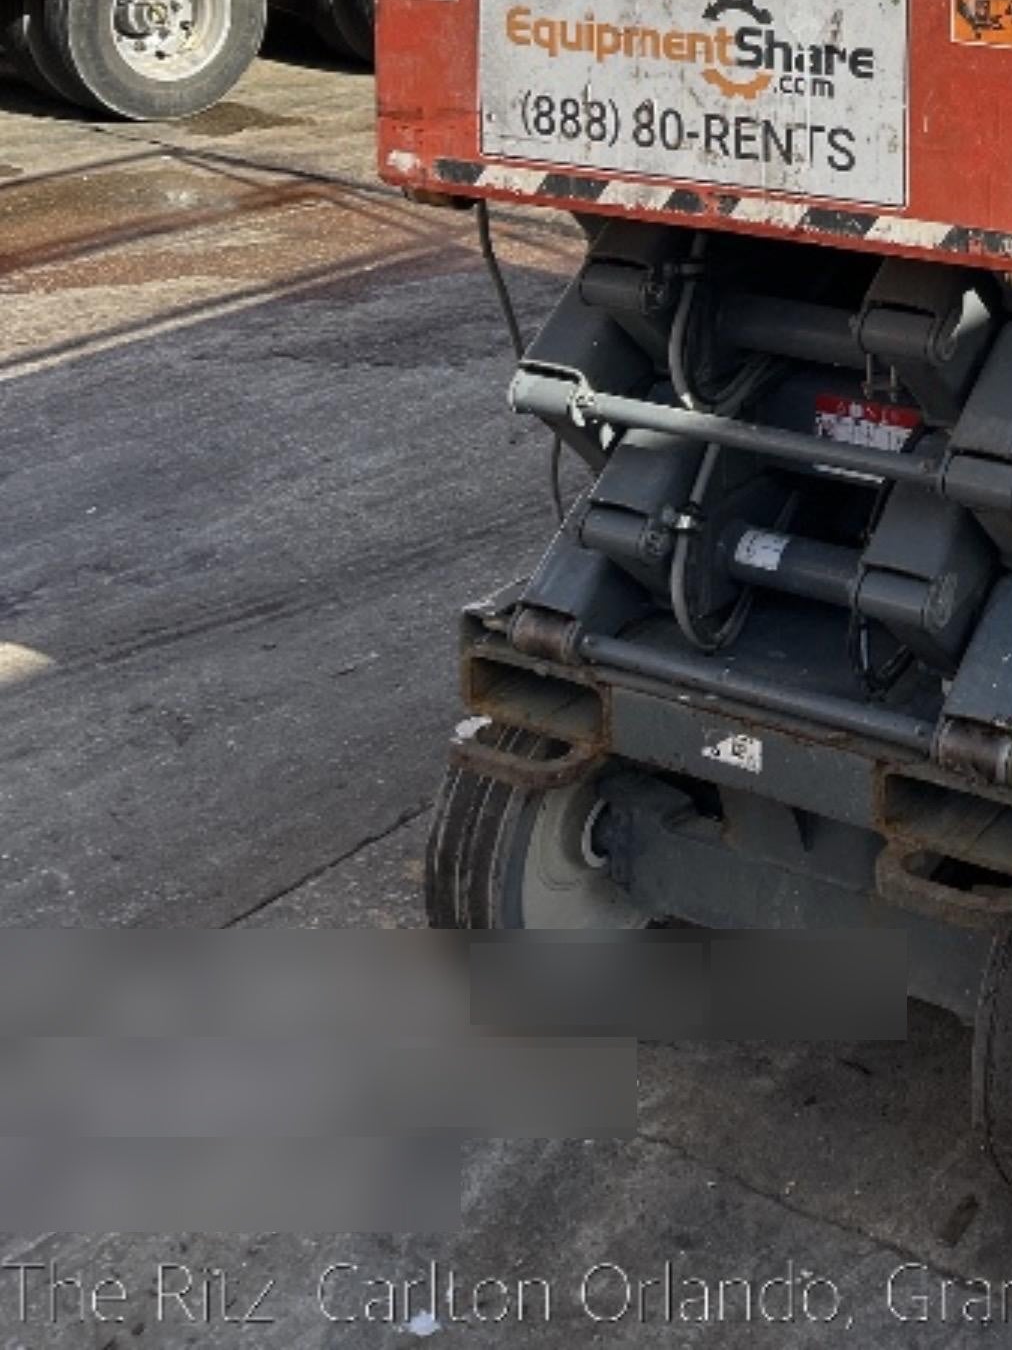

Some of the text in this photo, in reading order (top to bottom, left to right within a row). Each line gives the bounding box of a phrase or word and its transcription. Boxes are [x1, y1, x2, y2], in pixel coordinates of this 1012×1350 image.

[506, 5, 875, 80] EquipmentShare
[773, 75, 835, 99] .com
[521, 88, 857, 172] (888) 80-RENTS
